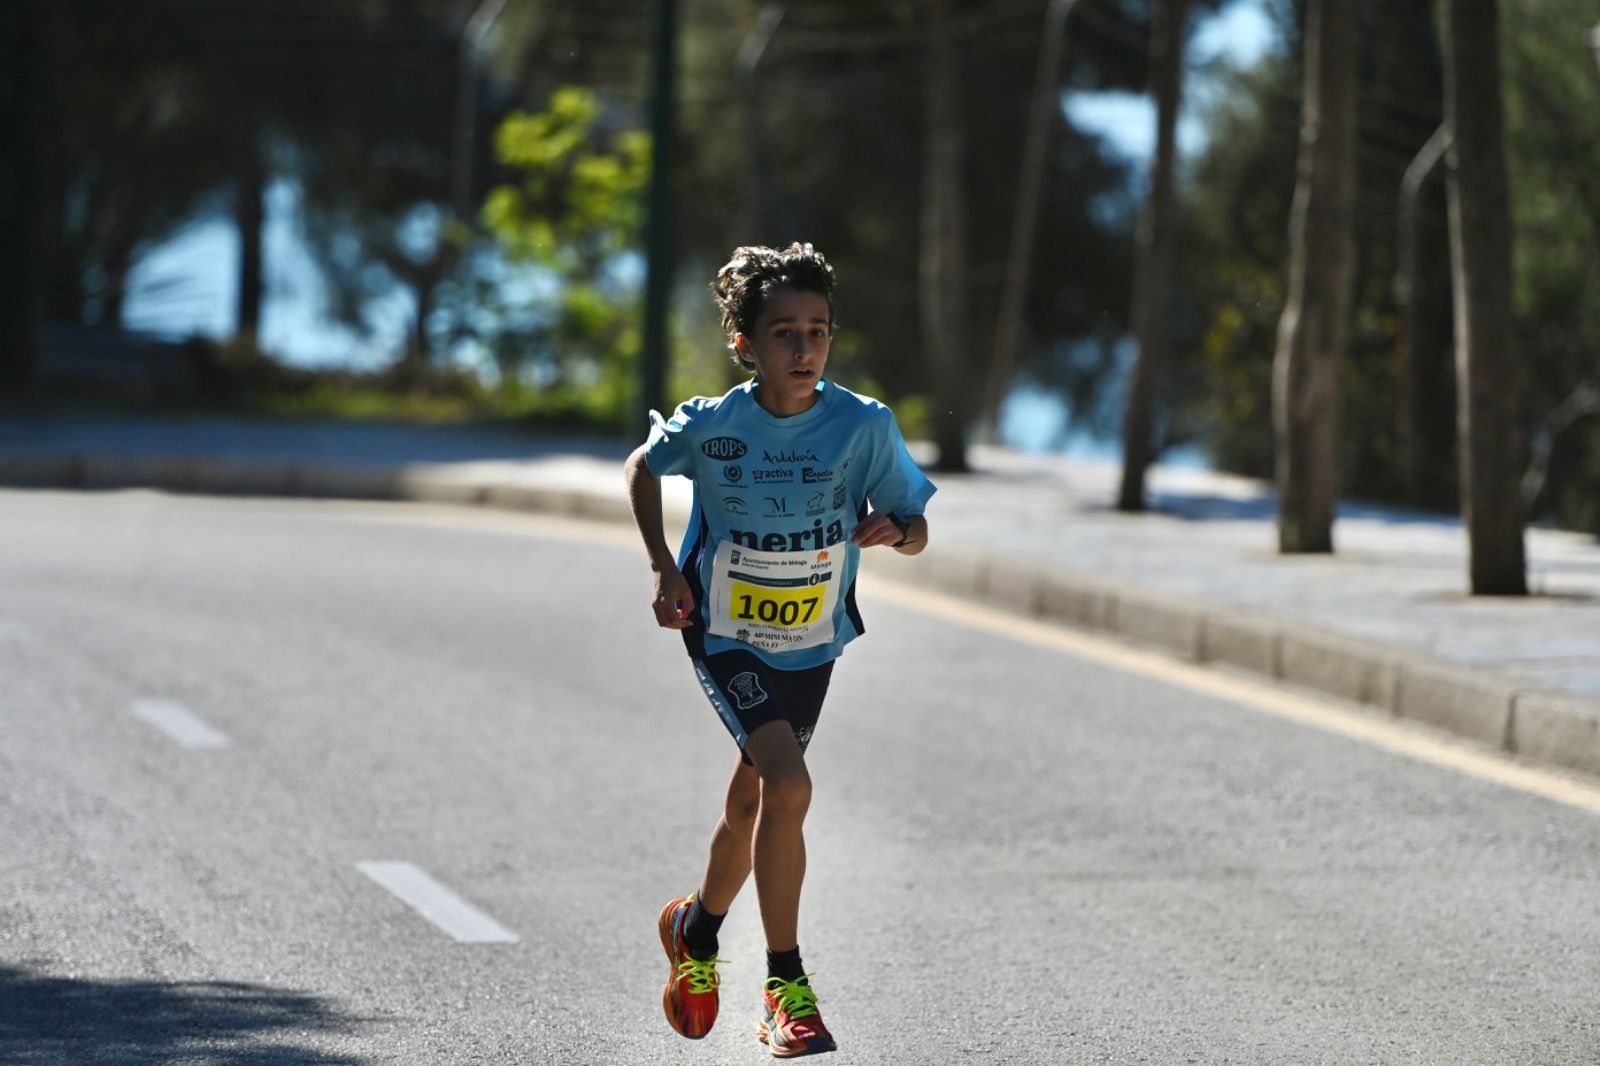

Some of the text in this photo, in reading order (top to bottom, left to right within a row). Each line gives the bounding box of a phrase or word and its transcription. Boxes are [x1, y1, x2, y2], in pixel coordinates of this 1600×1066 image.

[703, 438, 746, 457] TROPS
[762, 449, 821, 465] Andalucía
[765, 467, 794, 479] activa
[742, 556, 779, 566] Ayuntamiento
[789, 559, 808, 567] Málaga
[811, 561, 831, 570] Málaga
[738, 595, 818, 625] 1007
